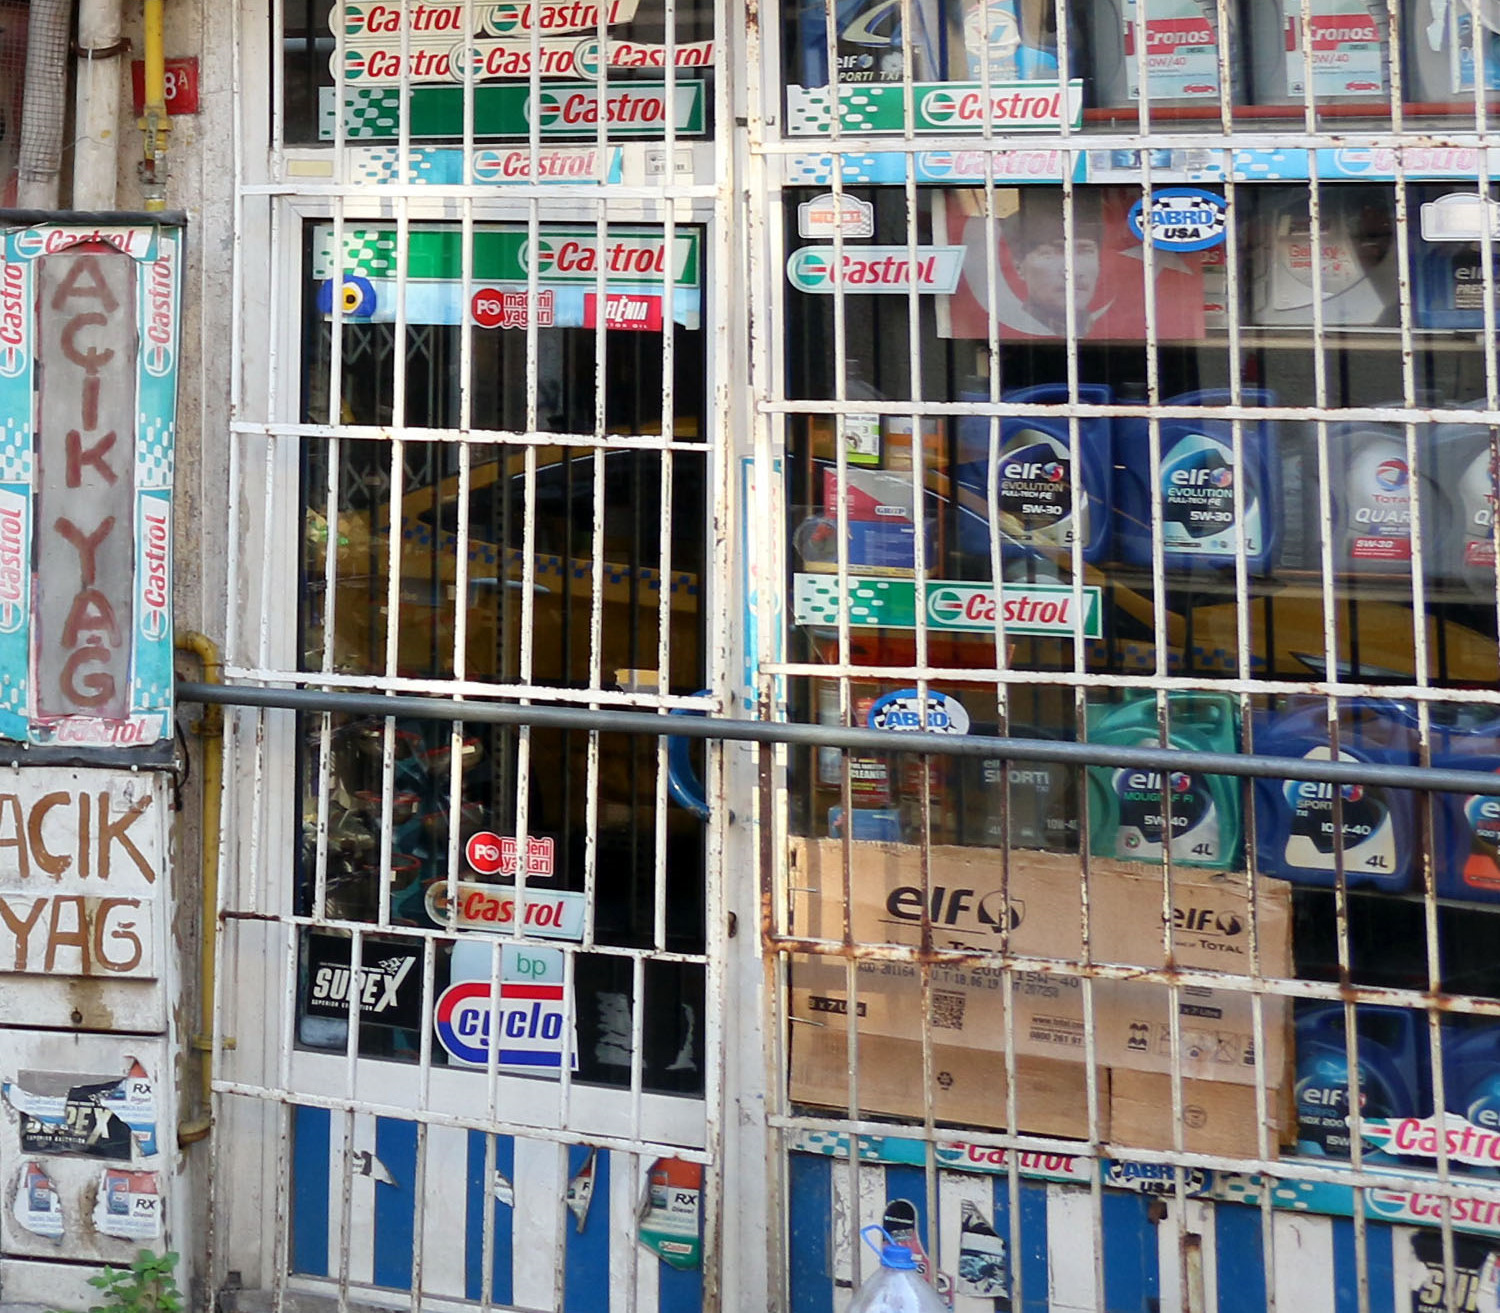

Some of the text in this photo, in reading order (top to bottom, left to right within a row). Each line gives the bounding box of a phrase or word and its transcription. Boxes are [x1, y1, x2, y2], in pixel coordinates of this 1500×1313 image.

[367, 5, 461, 32] Catrol
[1146, 30, 1211, 45] Cronos
[486, 47, 574, 74] Casro
[613, 43, 712, 66] Casrol
[368, 50, 450, 77] Catro
[839, 72, 873, 81] PORTI
[563, 93, 666, 123] Castro
[503, 152, 595, 177] Castrol
[1374, 148, 1478, 171] Cstro
[1163, 227, 1201, 239] USA
[557, 242, 665, 273] Catrol
[829, 255, 936, 284] Castrol
[505, 291, 551, 307] mani
[504, 308, 551, 325] yarı
[1004, 462, 1042, 479] elf
[1171, 469, 1210, 485] elf
[1001, 481, 1063, 492] EVOLUTION
[1168, 488, 1232, 498] EVOLUTION
[1372, 494, 1411, 503] TOTA
[1022, 504, 1063, 515] 5W-30
[1190, 511, 1232, 522] 5W-30
[1355, 508, 1412, 524] QUAR
[1356, 540, 1394, 548] 5W-30
[143, 514, 168, 609] Castrol
[965, 594, 1069, 624] Castrol
[984, 769, 1049, 785] SORTI
[1296, 800, 1333, 810] SPORT
[1144, 815, 1188, 827] 5W40
[502, 840, 550, 856] mdeni
[1191, 843, 1213, 856] 4L
[502, 857, 550, 874] yaları
[1365, 855, 1389, 868] 4L
[464, 892, 565, 927] Casrol
[886, 886, 973, 925] elf
[1161, 908, 1214, 930] elf
[1198, 939, 1244, 954] TOTAL
[517, 953, 546, 979] bp
[313, 956, 416, 1012] SUPEX
[459, 1003, 563, 1046] cyclo
[133, 1083, 152, 1094] RX
[1303, 1088, 1342, 1106] elf
[1395, 1118, 1500, 1162] Castro
[968, 1144, 1074, 1174] Catrol
[136, 1198, 157, 1209] RX
[674, 1193, 697, 1205] RX
[1409, 1193, 1500, 1225] Castr
